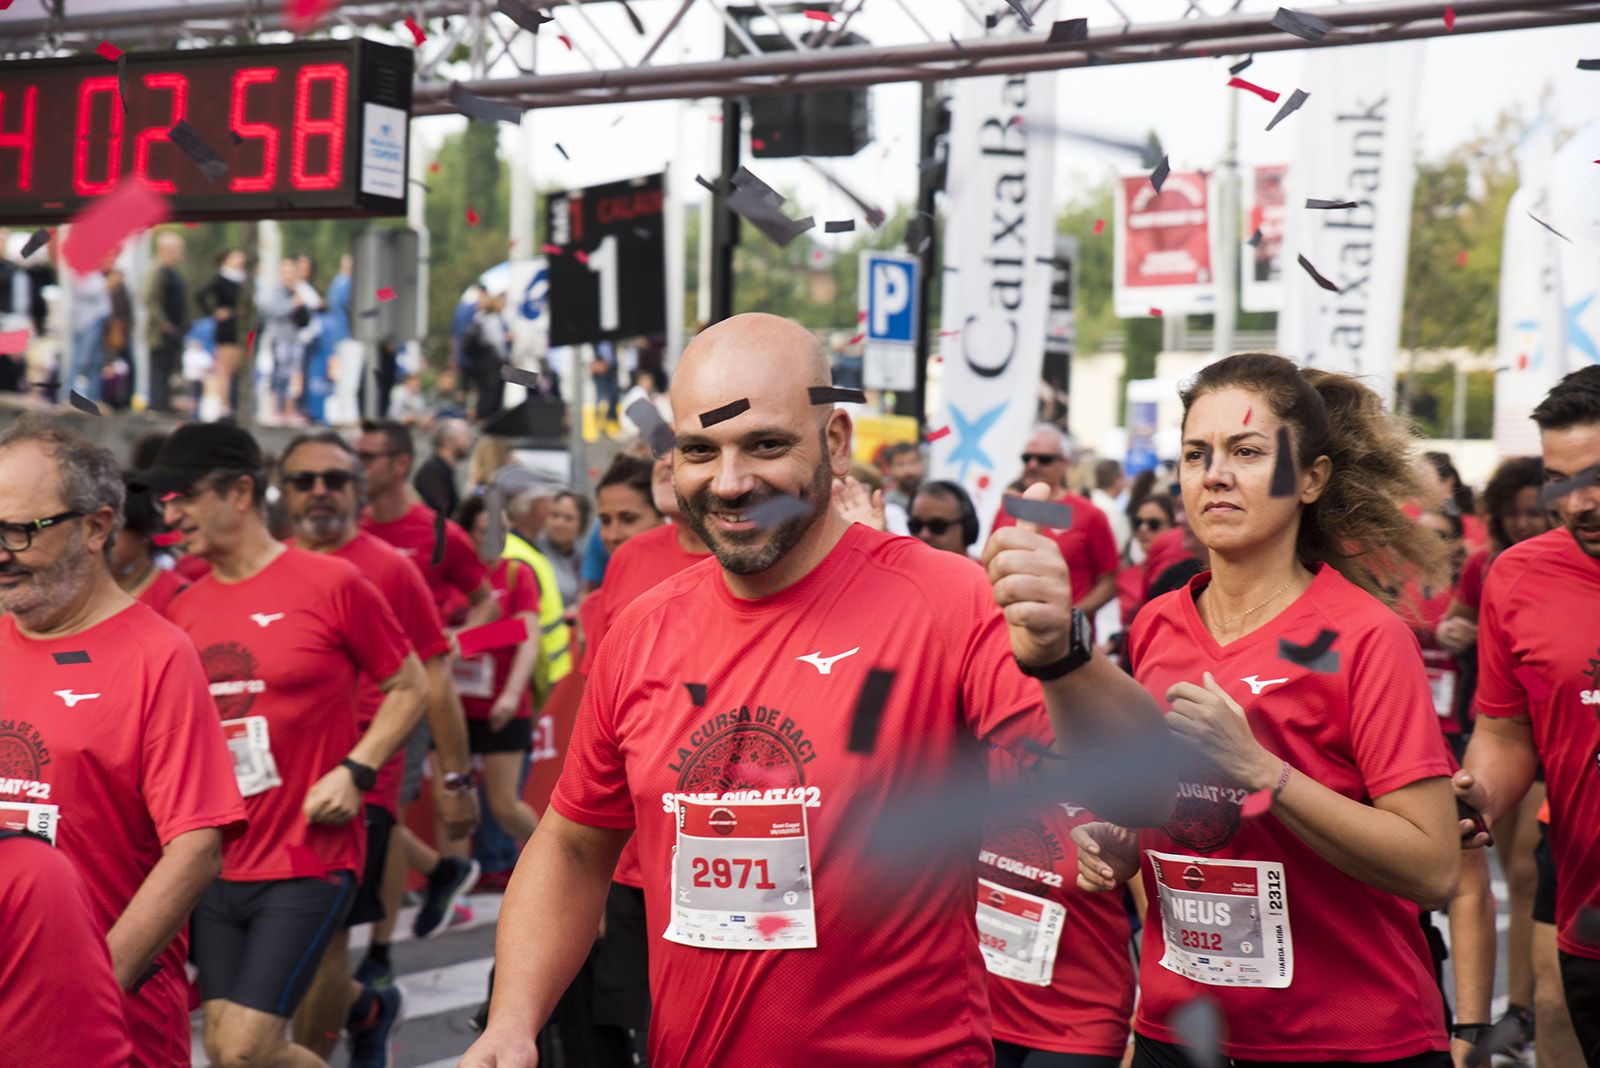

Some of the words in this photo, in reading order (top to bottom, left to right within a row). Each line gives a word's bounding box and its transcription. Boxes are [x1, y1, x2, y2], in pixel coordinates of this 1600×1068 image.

[72, 72, 188, 197] 02
[229, 63, 350, 193] 58
[588, 235, 619, 331] 1
[873, 263, 909, 336] P
[668, 749, 689, 773] LA
[690, 705, 751, 745] CURSA
[755, 705, 780, 728] DE
[780, 715, 817, 764] RAC1
[1176, 782, 1219, 802] UGAT
[692, 857, 776, 890] 2971
[997, 856, 1040, 881] CUGAT
[1268, 870, 1283, 911] 2312
[1171, 896, 1232, 927] NEUS
[1181, 929, 1223, 952] 2312
[1275, 925, 1286, 977] GUARDA-ROBA
